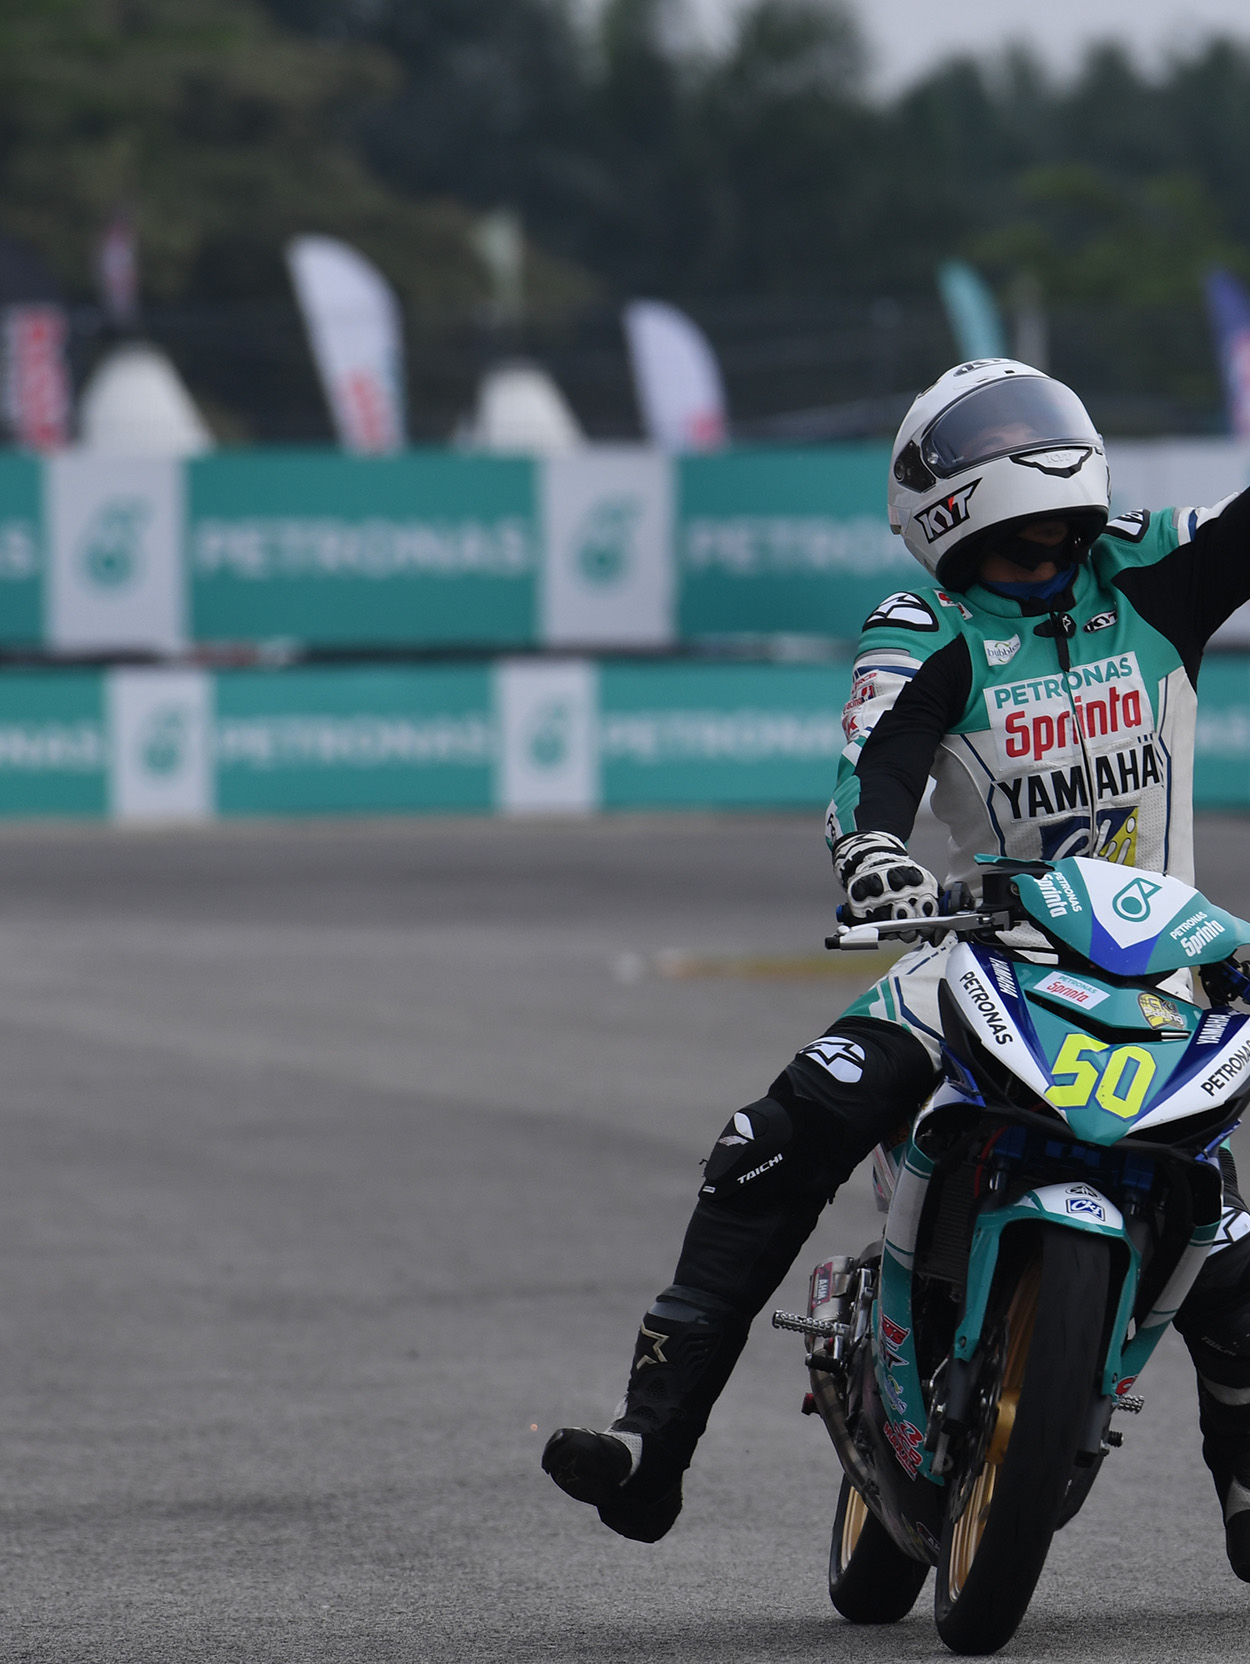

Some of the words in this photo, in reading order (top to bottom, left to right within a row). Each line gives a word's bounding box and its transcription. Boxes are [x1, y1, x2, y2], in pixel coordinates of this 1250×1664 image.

[917, 484, 976, 539] KYT
[994, 657, 1133, 709] PETRONAS
[1005, 687, 1142, 761] Sprinta
[997, 743, 1160, 820] YAMAHA
[1034, 874, 1067, 918] Sprinta
[1053, 872, 1082, 912] PETRONAS
[1169, 911, 1208, 940] PETRONAS
[1180, 920, 1225, 957] Sprinta
[1047, 980, 1090, 1003] Sprinta
[1058, 975, 1098, 995] PETRONAS
[959, 971, 1013, 1045] PETRONAS
[1196, 1014, 1231, 1045] YAMAHA
[1046, 1032, 1157, 1119] 50
[737, 1153, 783, 1184] TAICHI
